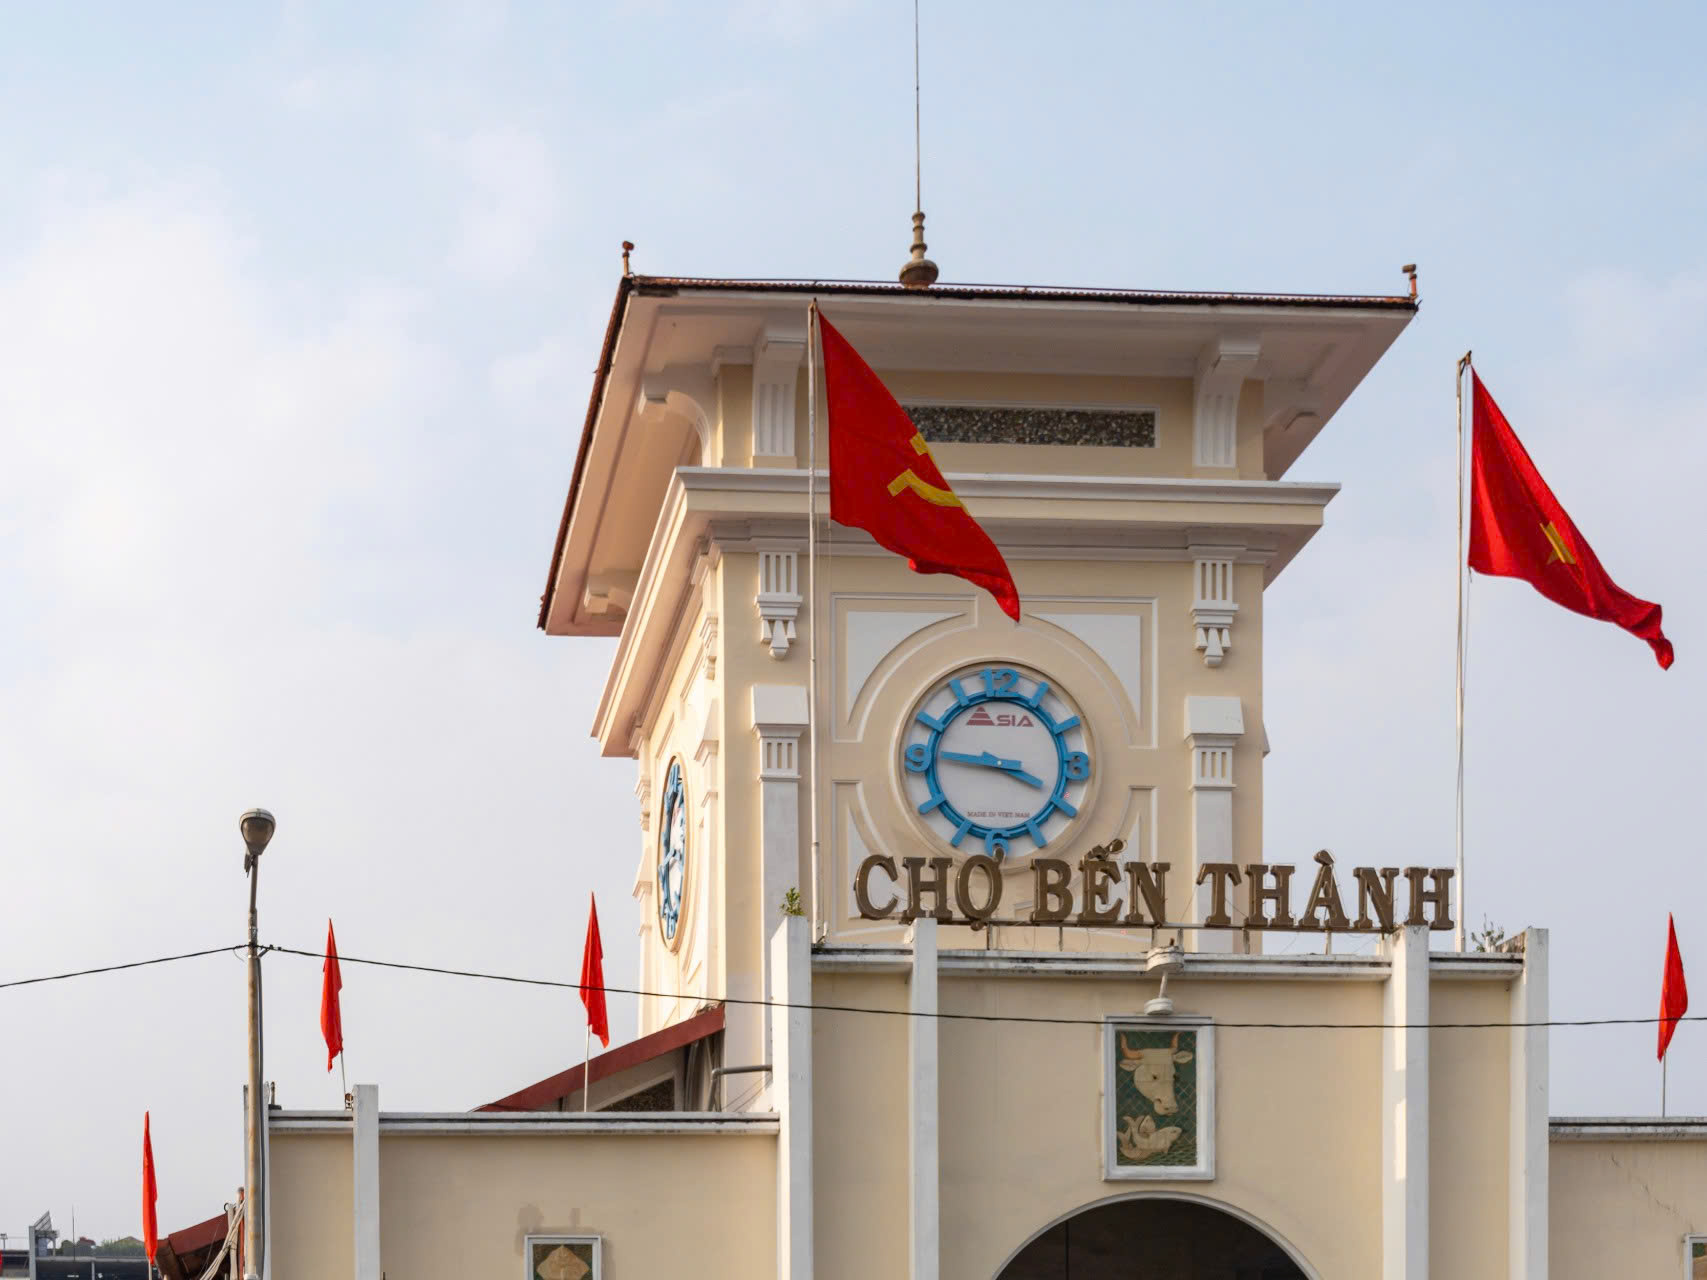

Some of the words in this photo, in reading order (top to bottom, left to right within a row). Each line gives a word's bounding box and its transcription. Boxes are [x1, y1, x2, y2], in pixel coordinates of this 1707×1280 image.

[980, 667, 1020, 697] 12
[966, 706, 1034, 727] ASIA
[904, 743, 932, 773] 9
[1064, 751, 1091, 781] 3
[854, 848, 1004, 930] CHỢ
[1030, 839, 1170, 926] BẾN
[1196, 849, 1455, 932] THÀNH
